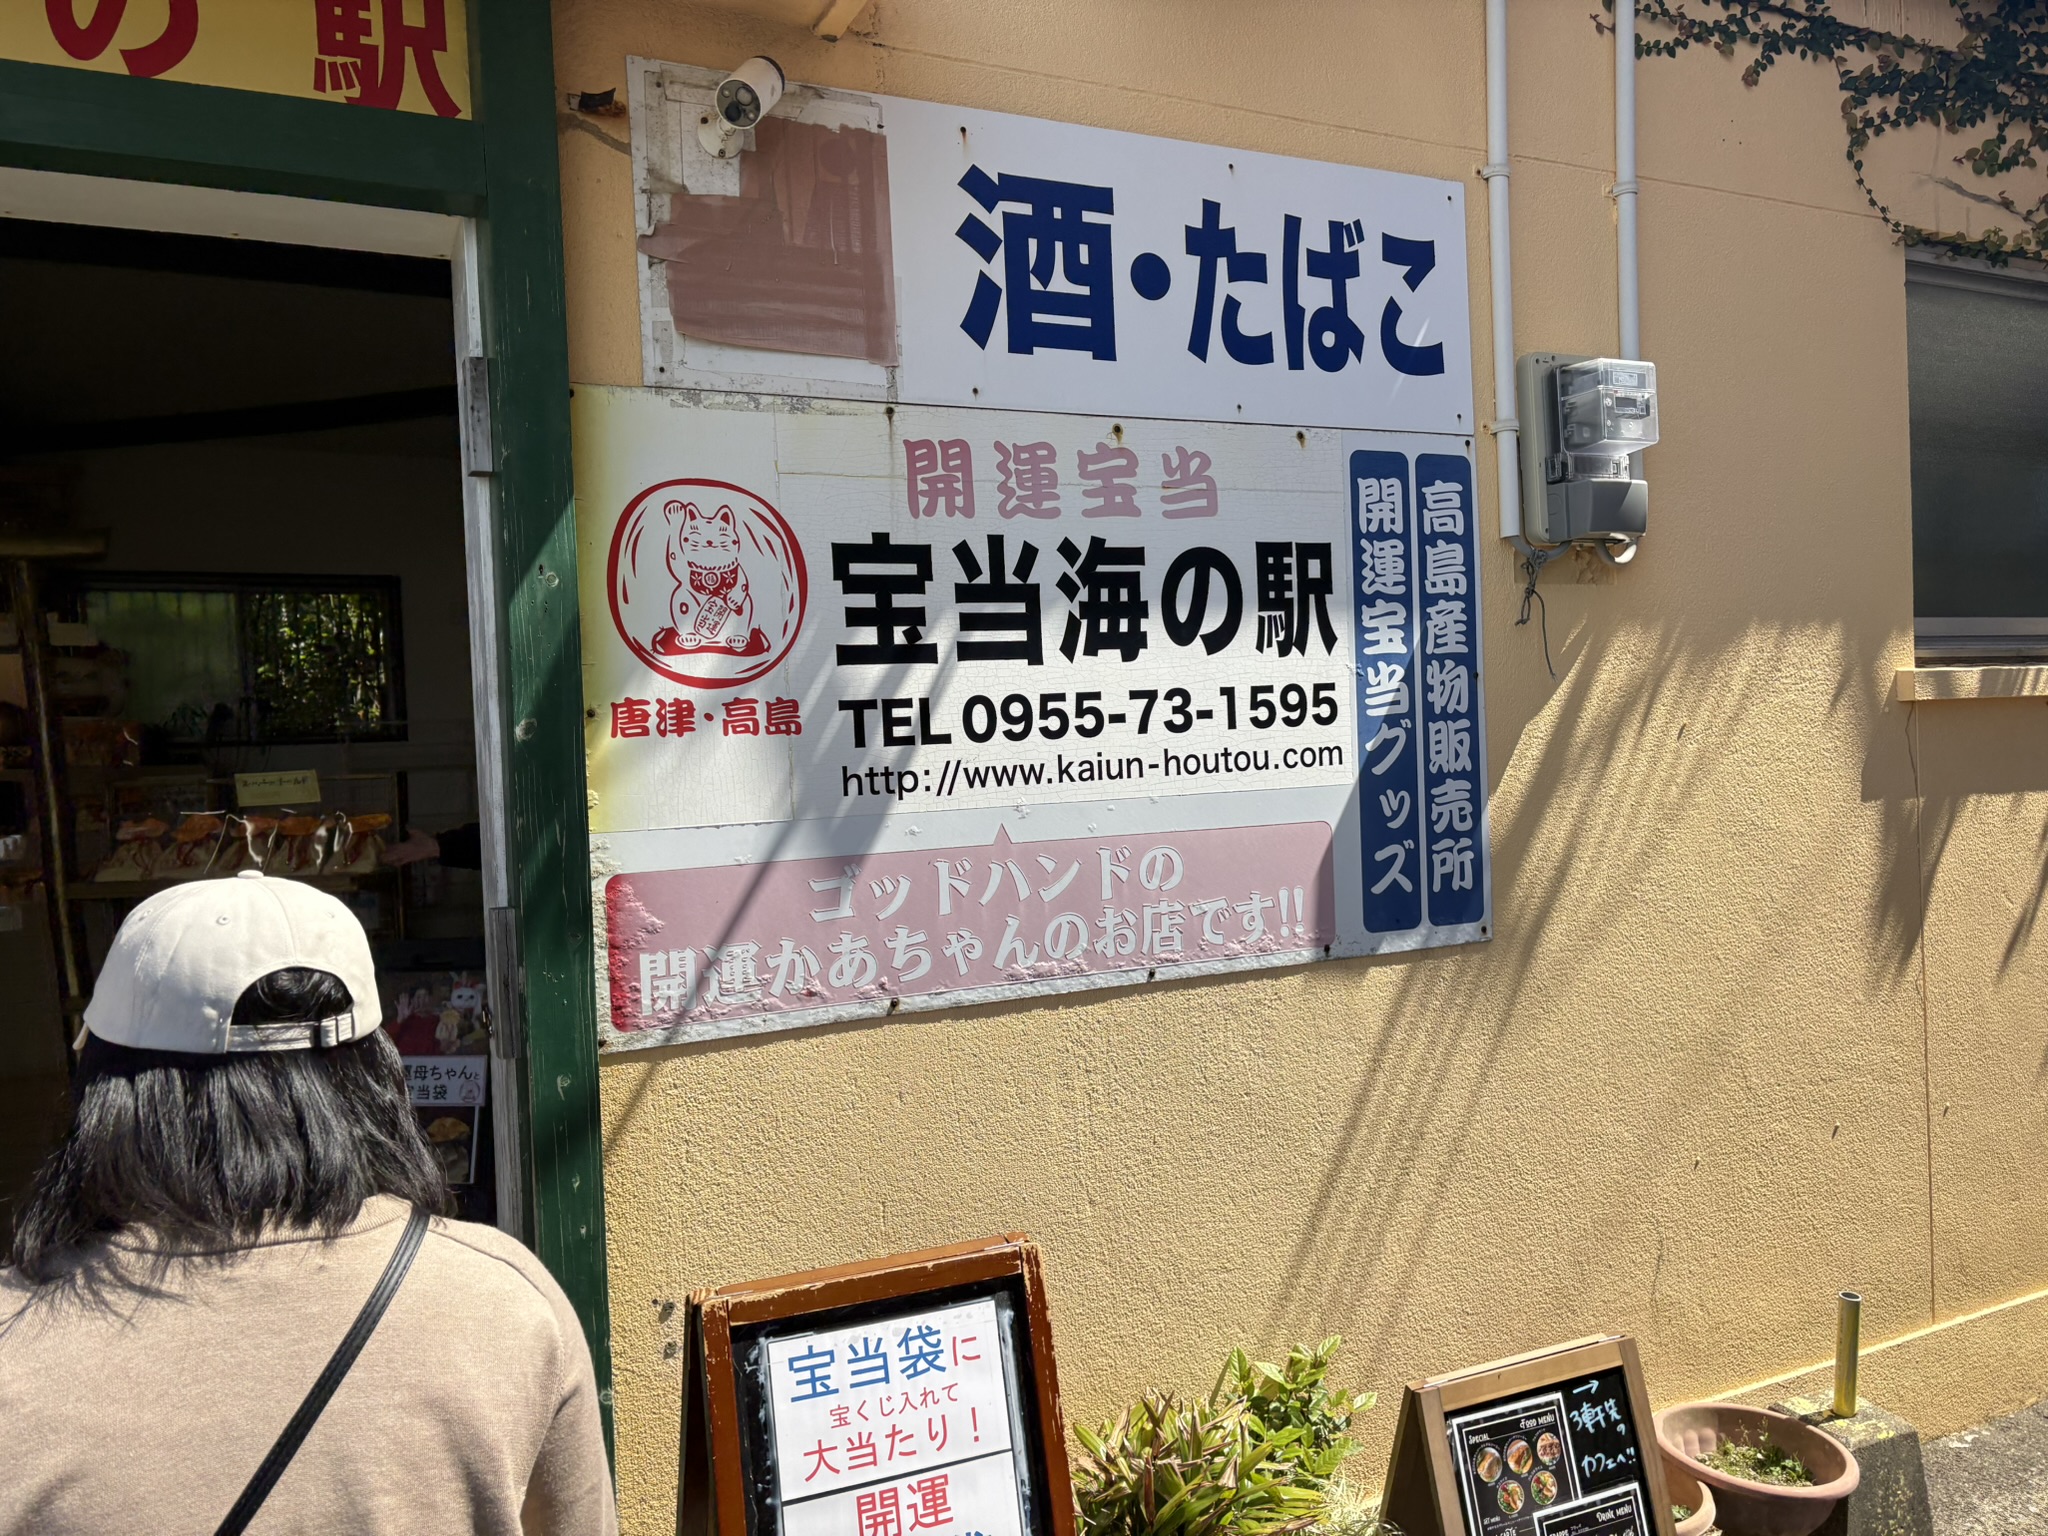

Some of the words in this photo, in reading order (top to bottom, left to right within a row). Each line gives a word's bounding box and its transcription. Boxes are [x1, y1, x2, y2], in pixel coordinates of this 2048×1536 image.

[955, 164, 1445, 377] 酒・たばこ
[903, 438, 1218, 519] 開運宝当
[831, 532, 1338, 666] 宝当海の駅
[610, 697, 802, 738] 唐津・高島
[838, 698, 951, 749] TEL
[962, 682, 1339, 743] 0955-73-1595
[1357, 477, 1413, 895] 開運宝当グッズ
[1422, 480, 1475, 894] 高島産物販売所
[841, 745, 1343, 801] http://www.kaiun-houtou.com
[808, 845, 1184, 922] ゴッドハンドの
[788, 1324, 981, 1403] 宝当袋に
[829, 1383, 958, 1429] 宝くじ入れて
[1537, 1412, 1555, 1426] MENU
[856, 1474, 953, 1536] 開運
[1615, 1503, 1632, 1517] MENU
